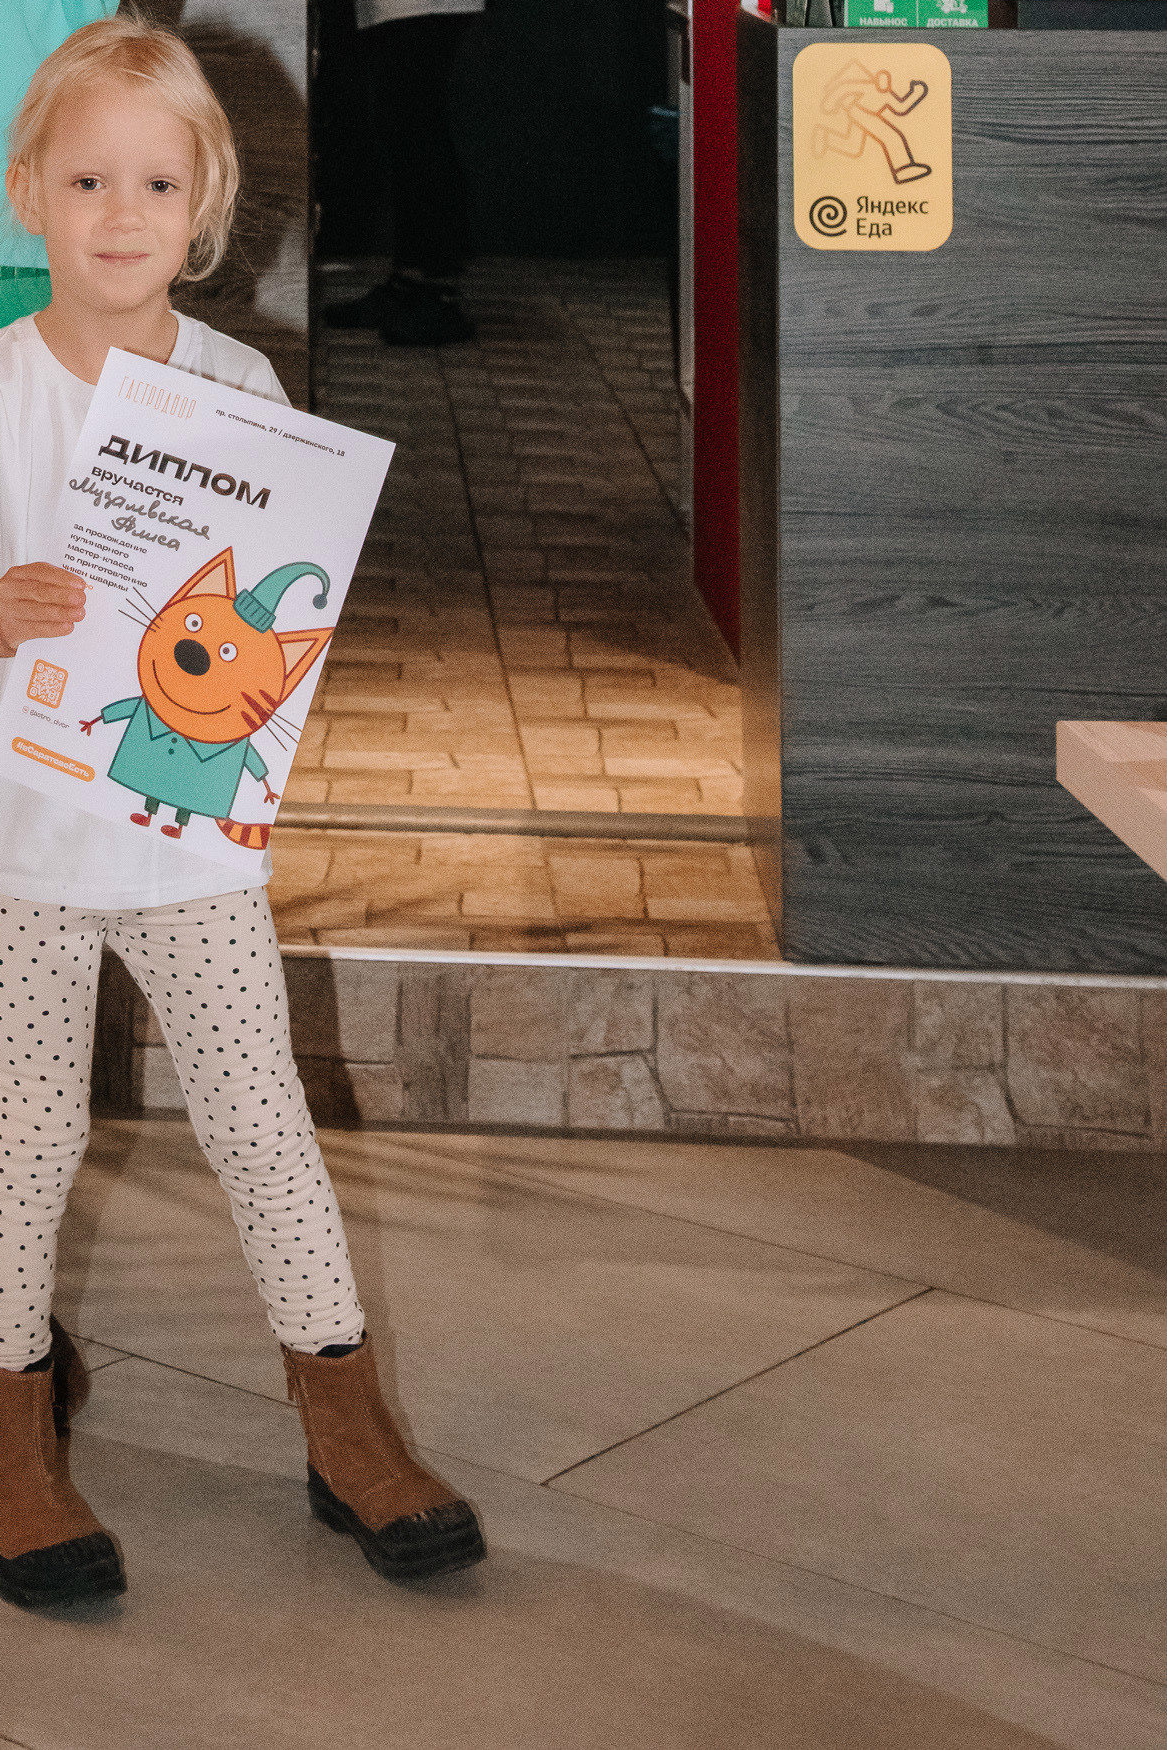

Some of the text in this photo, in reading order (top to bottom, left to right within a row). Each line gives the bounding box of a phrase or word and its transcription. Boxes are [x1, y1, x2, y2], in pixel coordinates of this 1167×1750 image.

[859, 17, 908, 26] НАВЫНОС
[927, 17, 978, 27] ДОСТАВКА
[856, 196, 929, 216] Яндекс
[856, 218, 892, 238] Еда
[118, 376, 197, 419] ГАСТРОДВОР
[215, 408, 227, 417] пр.
[269, 426, 278, 434] 29
[98, 435, 272, 510] ДИПЛОМ
[91, 466, 184, 506] вручается
[70, 533, 129, 559] кулинарного
[73, 523, 147, 554] за прохождение
[64, 553, 75, 562] по
[76, 558, 148, 588] приготовлению
[67, 543, 134, 572] мастер-класса
[89, 575, 129, 592] швармы
